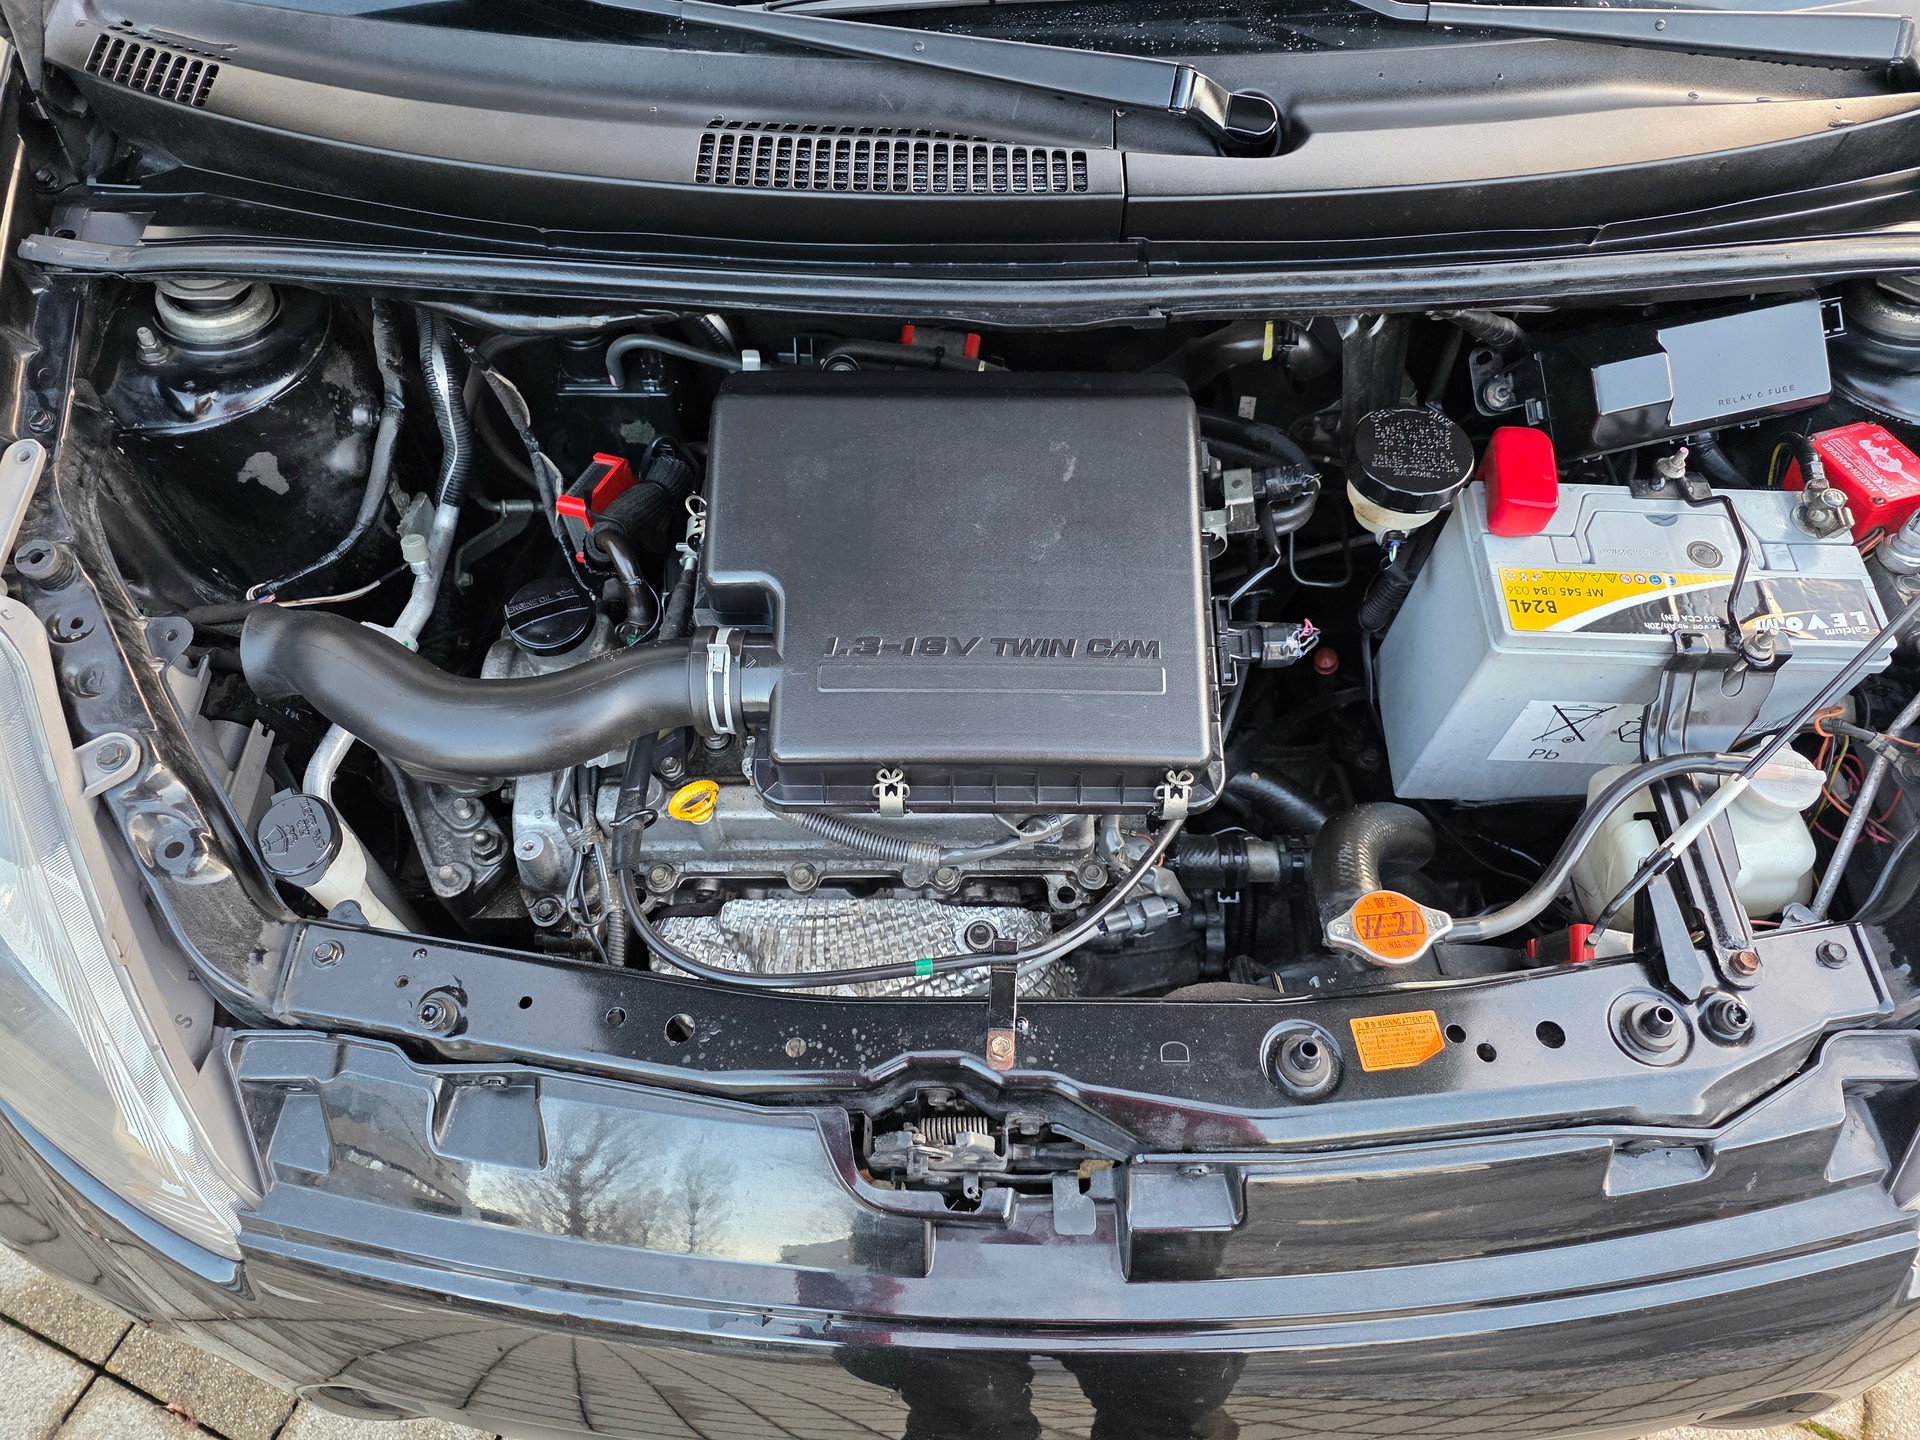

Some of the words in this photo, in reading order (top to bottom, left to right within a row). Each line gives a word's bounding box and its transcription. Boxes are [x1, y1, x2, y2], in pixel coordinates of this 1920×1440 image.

[1718, 393, 1752, 406] RELAY
[1768, 384, 1796, 396] FUSE
[1820, 441, 1878, 492] MARTEN-BANISHER
[1506, 585, 1529, 595] 036
[1533, 586, 1556, 596] 084
[1559, 587, 1582, 597] 545
[1586, 588, 1604, 597] MF
[507, 598, 538, 613] ENGINE
[1510, 599, 1557, 614] B24L
[1661, 612, 1680, 622] (EN)
[1681, 614, 1702, 622] CCA
[1704, 615, 1720, 623] 360
[1785, 611, 1868, 631] LEVO
[1643, 621, 1676, 631] Ah/20h
[1824, 626, 1870, 636] Calcium
[823, 636, 982, 657] 1.3-16V
[990, 637, 1078, 658] TWIN
[1086, 638, 1161, 659] CAM
[1527, 748, 1560, 760] Pb
[1373, 895, 1398, 909] 警告
[1387, 939, 1417, 950] WARNING
[1377, 1017, 1401, 1028] WARNING
[1402, 1013, 1434, 1025] ATTENTION
